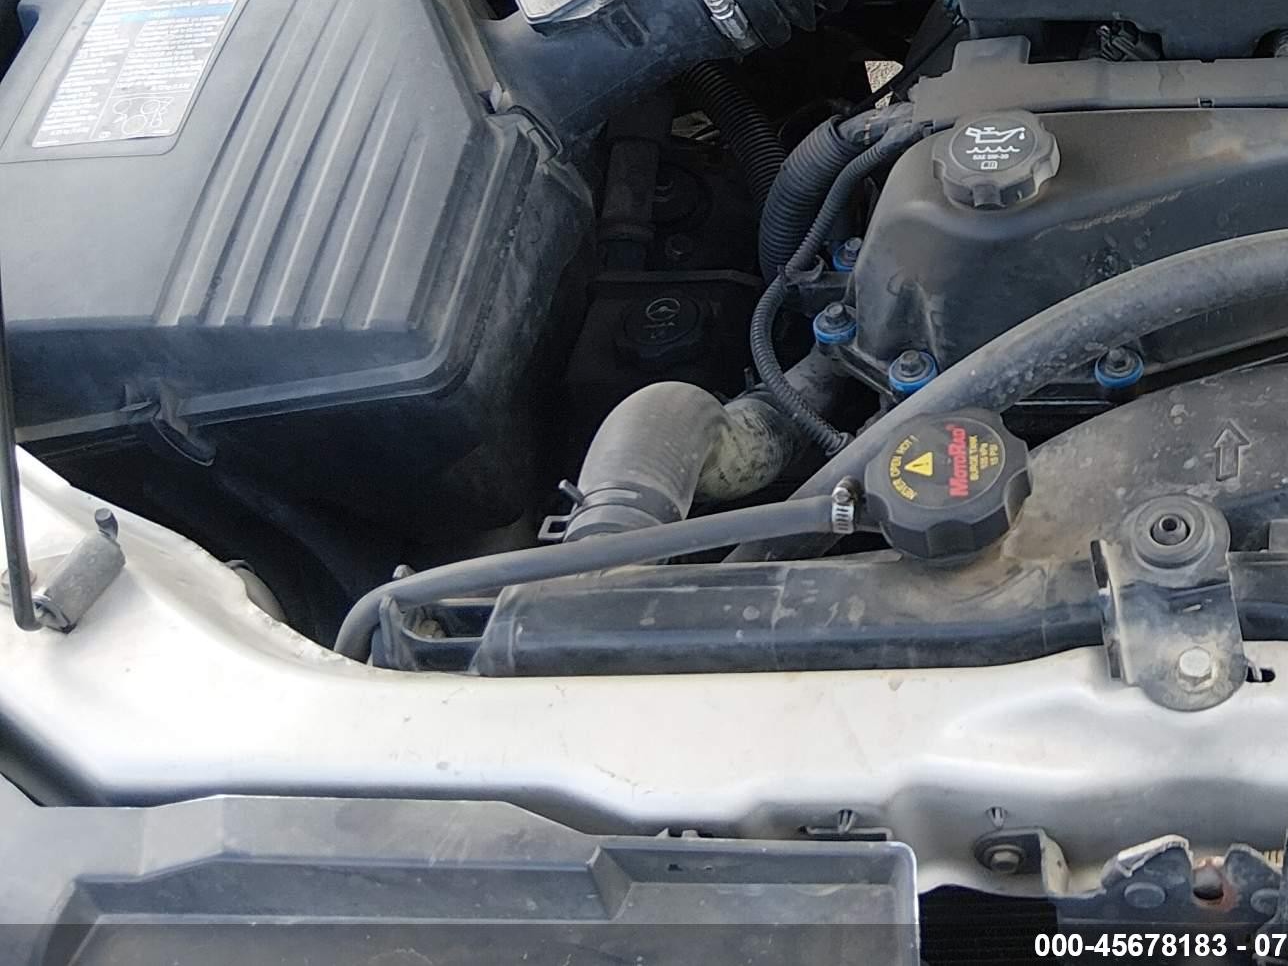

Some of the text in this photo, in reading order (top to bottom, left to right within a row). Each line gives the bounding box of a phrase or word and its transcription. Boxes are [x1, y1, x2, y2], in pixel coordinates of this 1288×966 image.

[895, 438, 913, 455] HOT
[968, 434, 980, 482] SURGE TANK
[890, 455, 903, 478] OPEN
